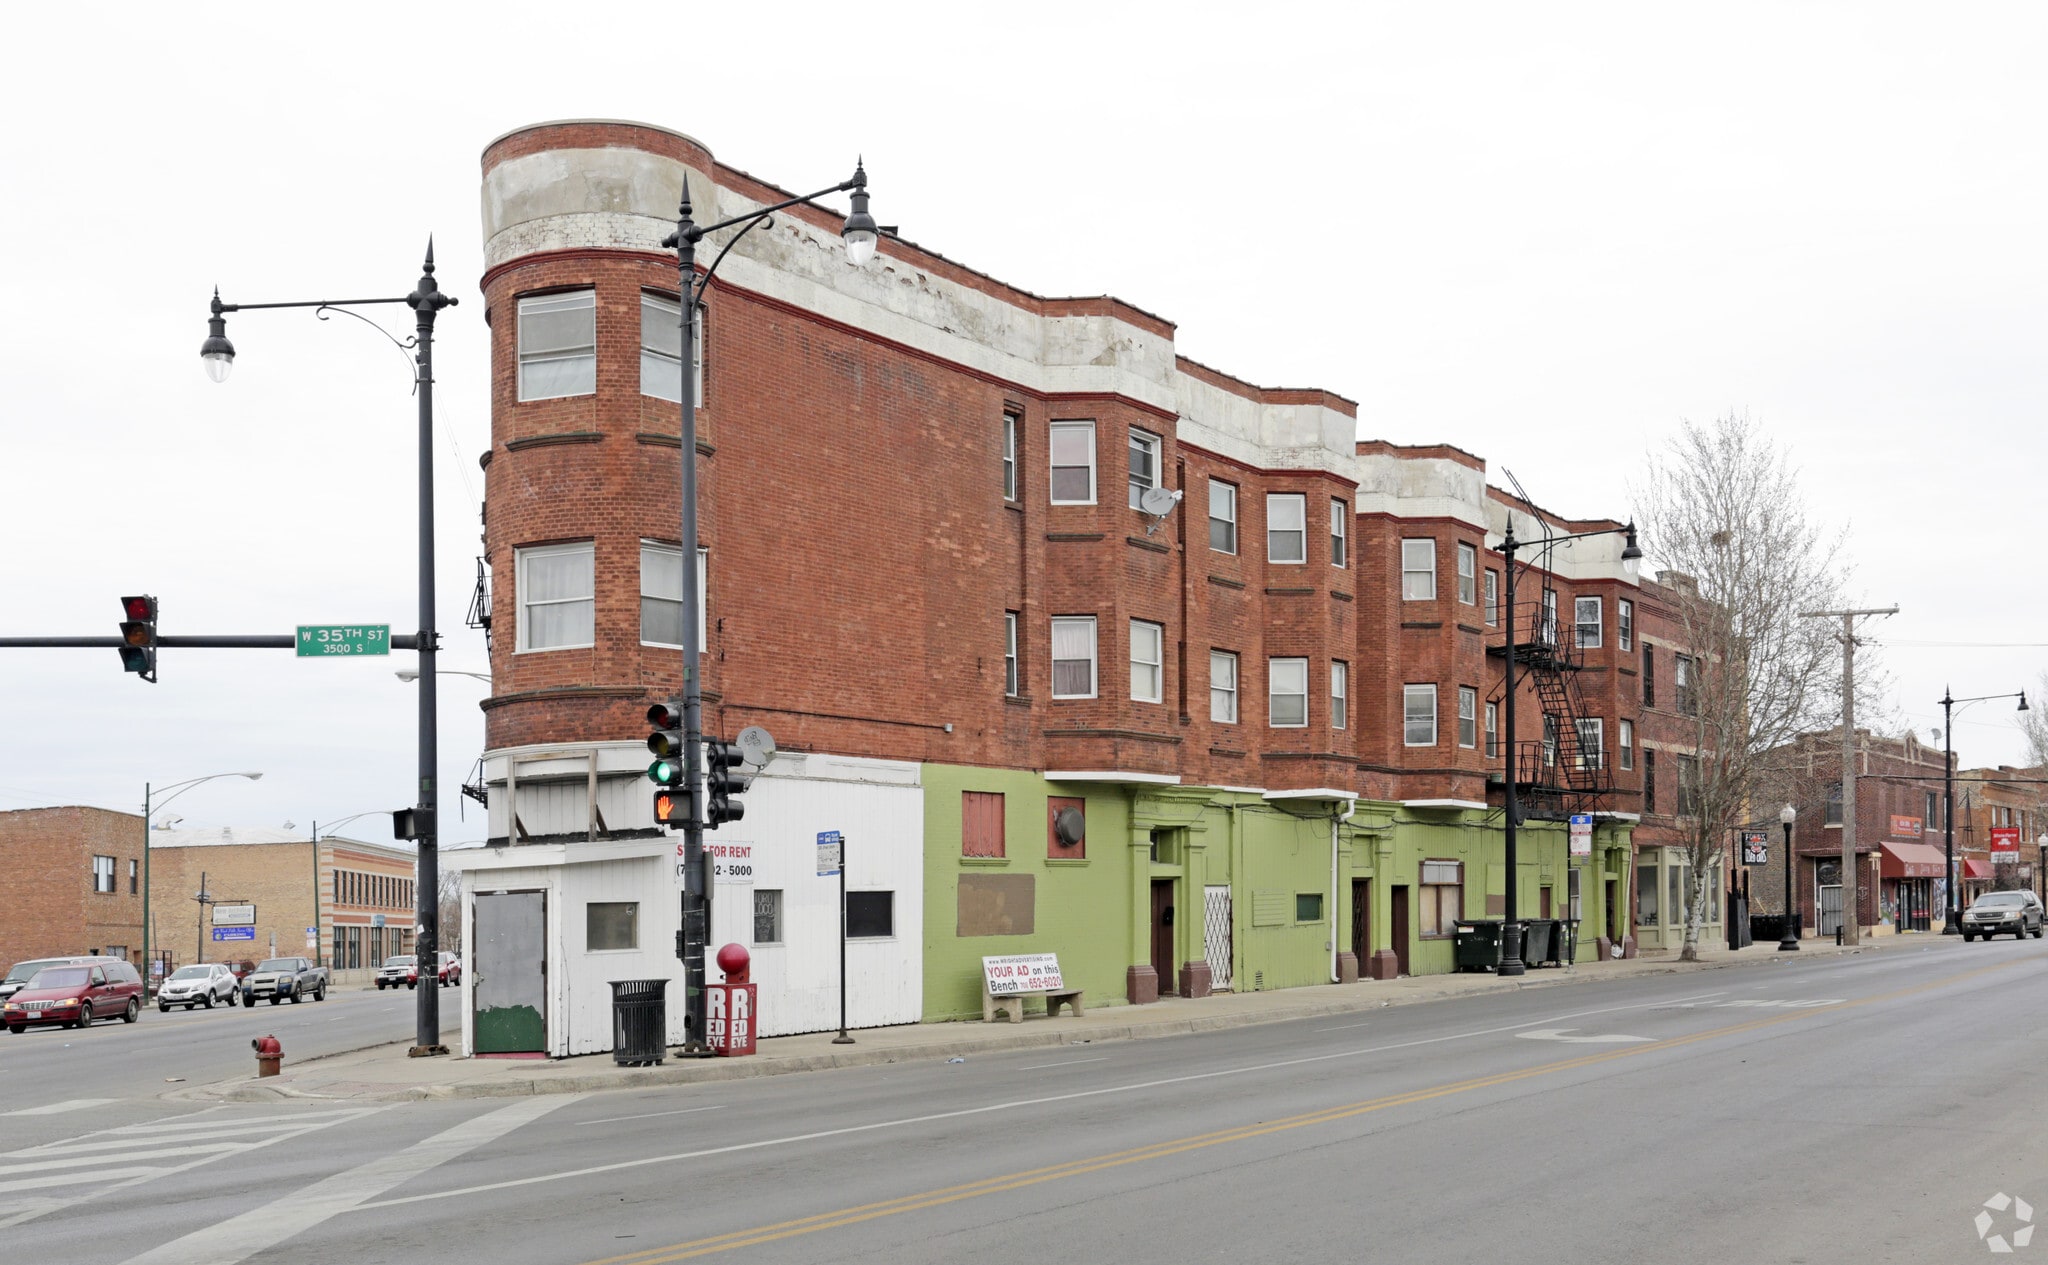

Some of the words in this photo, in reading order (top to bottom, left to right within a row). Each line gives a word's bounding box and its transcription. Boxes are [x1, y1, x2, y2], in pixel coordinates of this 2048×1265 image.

[302, 631, 311, 641] W
[317, 629, 362, 642] 35TH
[367, 630, 384, 641] ST
[323, 644, 350, 653] 3500
[356, 643, 363, 653] S
[709, 845, 727, 858] FOR
[729, 846, 751, 858] RENT
[729, 865, 752, 876] 5000
[987, 966, 1013, 978] YOUR
[1017, 965, 1029, 976] AD
[1032, 967, 1042, 975] on
[1044, 964, 1059, 974] this
[990, 980, 1018, 992] Bench
[1028, 976, 1062, 989] 652-6020
[707, 988, 726, 1019] R
[732, 988, 748, 1019] R
[706, 1019, 725, 1036] ED
[731, 1019, 748, 1036] ED
[706, 1035, 725, 1047] EYE
[731, 1036, 748, 1049] EYE
